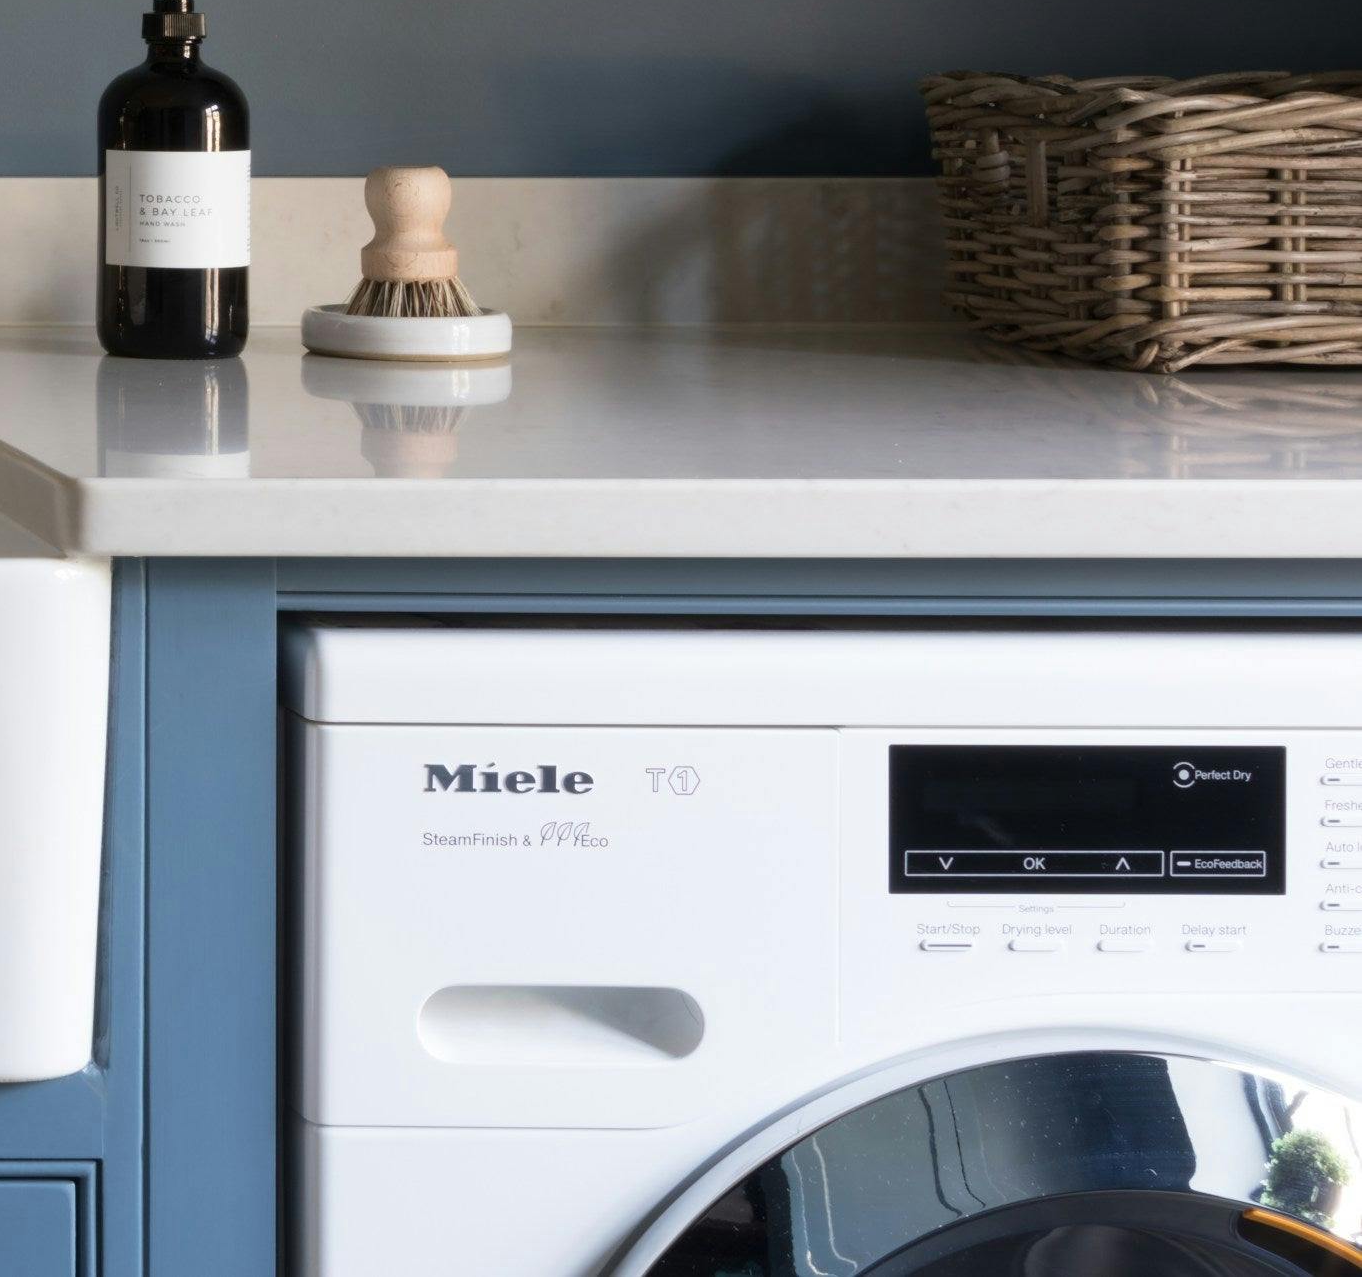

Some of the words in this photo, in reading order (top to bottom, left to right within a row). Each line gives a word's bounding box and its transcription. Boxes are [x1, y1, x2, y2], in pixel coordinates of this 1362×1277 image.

[139, 194, 201, 204] TOBACCO
[139, 207, 146, 216] &
[152, 207, 177, 216] BAY
[183, 208, 213, 217] LEAF
[423, 762, 594, 794] Miele
[1194, 769, 1230, 782] Perfect
[1232, 769, 1252, 784] Dry
[423, 832, 518, 847] SteamFinish
[522, 834, 532, 847] &
[581, 834, 609, 848] Eco
[1325, 841, 1354, 853] Auto
[1023, 857, 1046, 870] OK
[1194, 858, 1263, 870] EcoFeedback
[1018, 903, 1055, 915] Settings
[916, 923, 981, 937] Start/Stop
[1002, 923, 1042, 938] Drying
[1044, 923, 1072, 935] level
[1099, 923, 1152, 935] Duration
[1181, 923, 1215, 938] Delay
[1218, 924, 1247, 935] start
